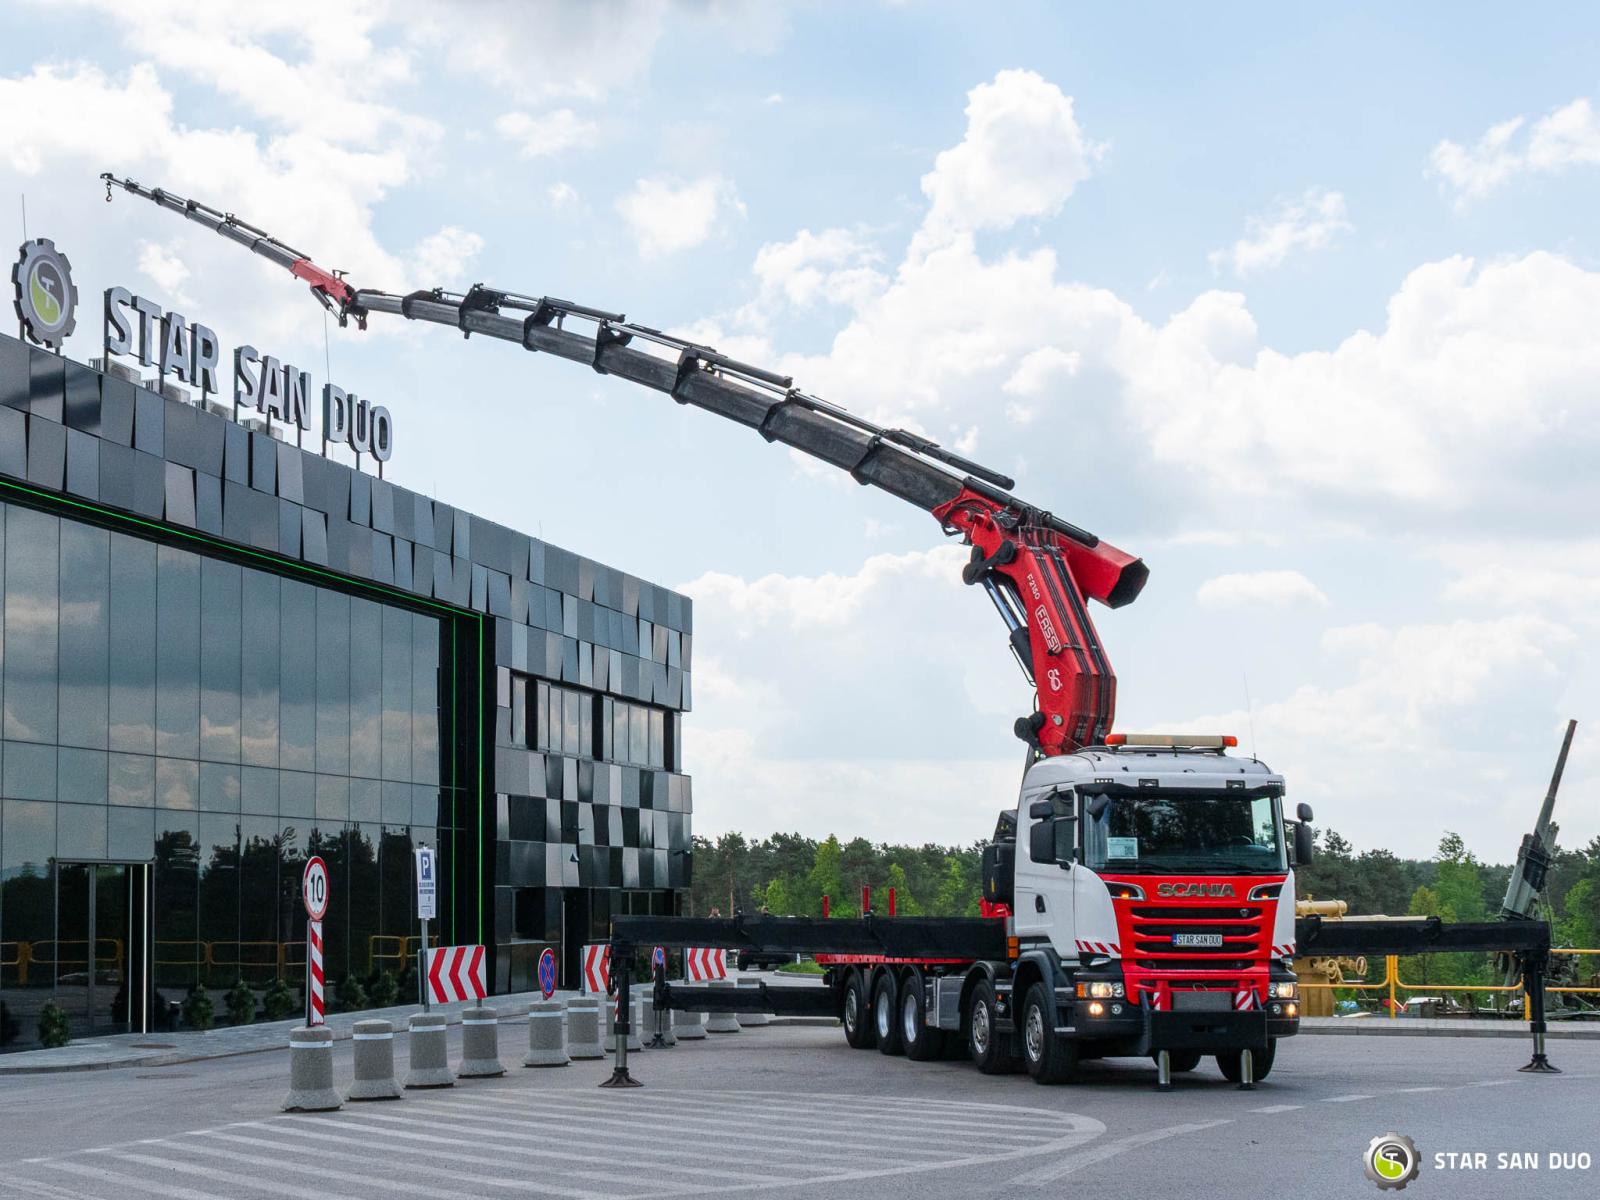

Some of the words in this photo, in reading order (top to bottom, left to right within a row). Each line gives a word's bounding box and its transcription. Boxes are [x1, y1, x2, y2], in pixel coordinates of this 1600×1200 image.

[104, 286, 219, 394] STAR
[234, 345, 311, 431] SAN
[323, 383, 393, 462] DUO
[1037, 607, 1060, 652] FASSI
[422, 856, 430, 876] P
[310, 873, 324, 904] 10
[1157, 883, 1236, 897] SCANIA
[1177, 935, 1194, 945] STAR
[1195, 935, 1208, 945] SAN
[1209, 935, 1221, 945] DUO
